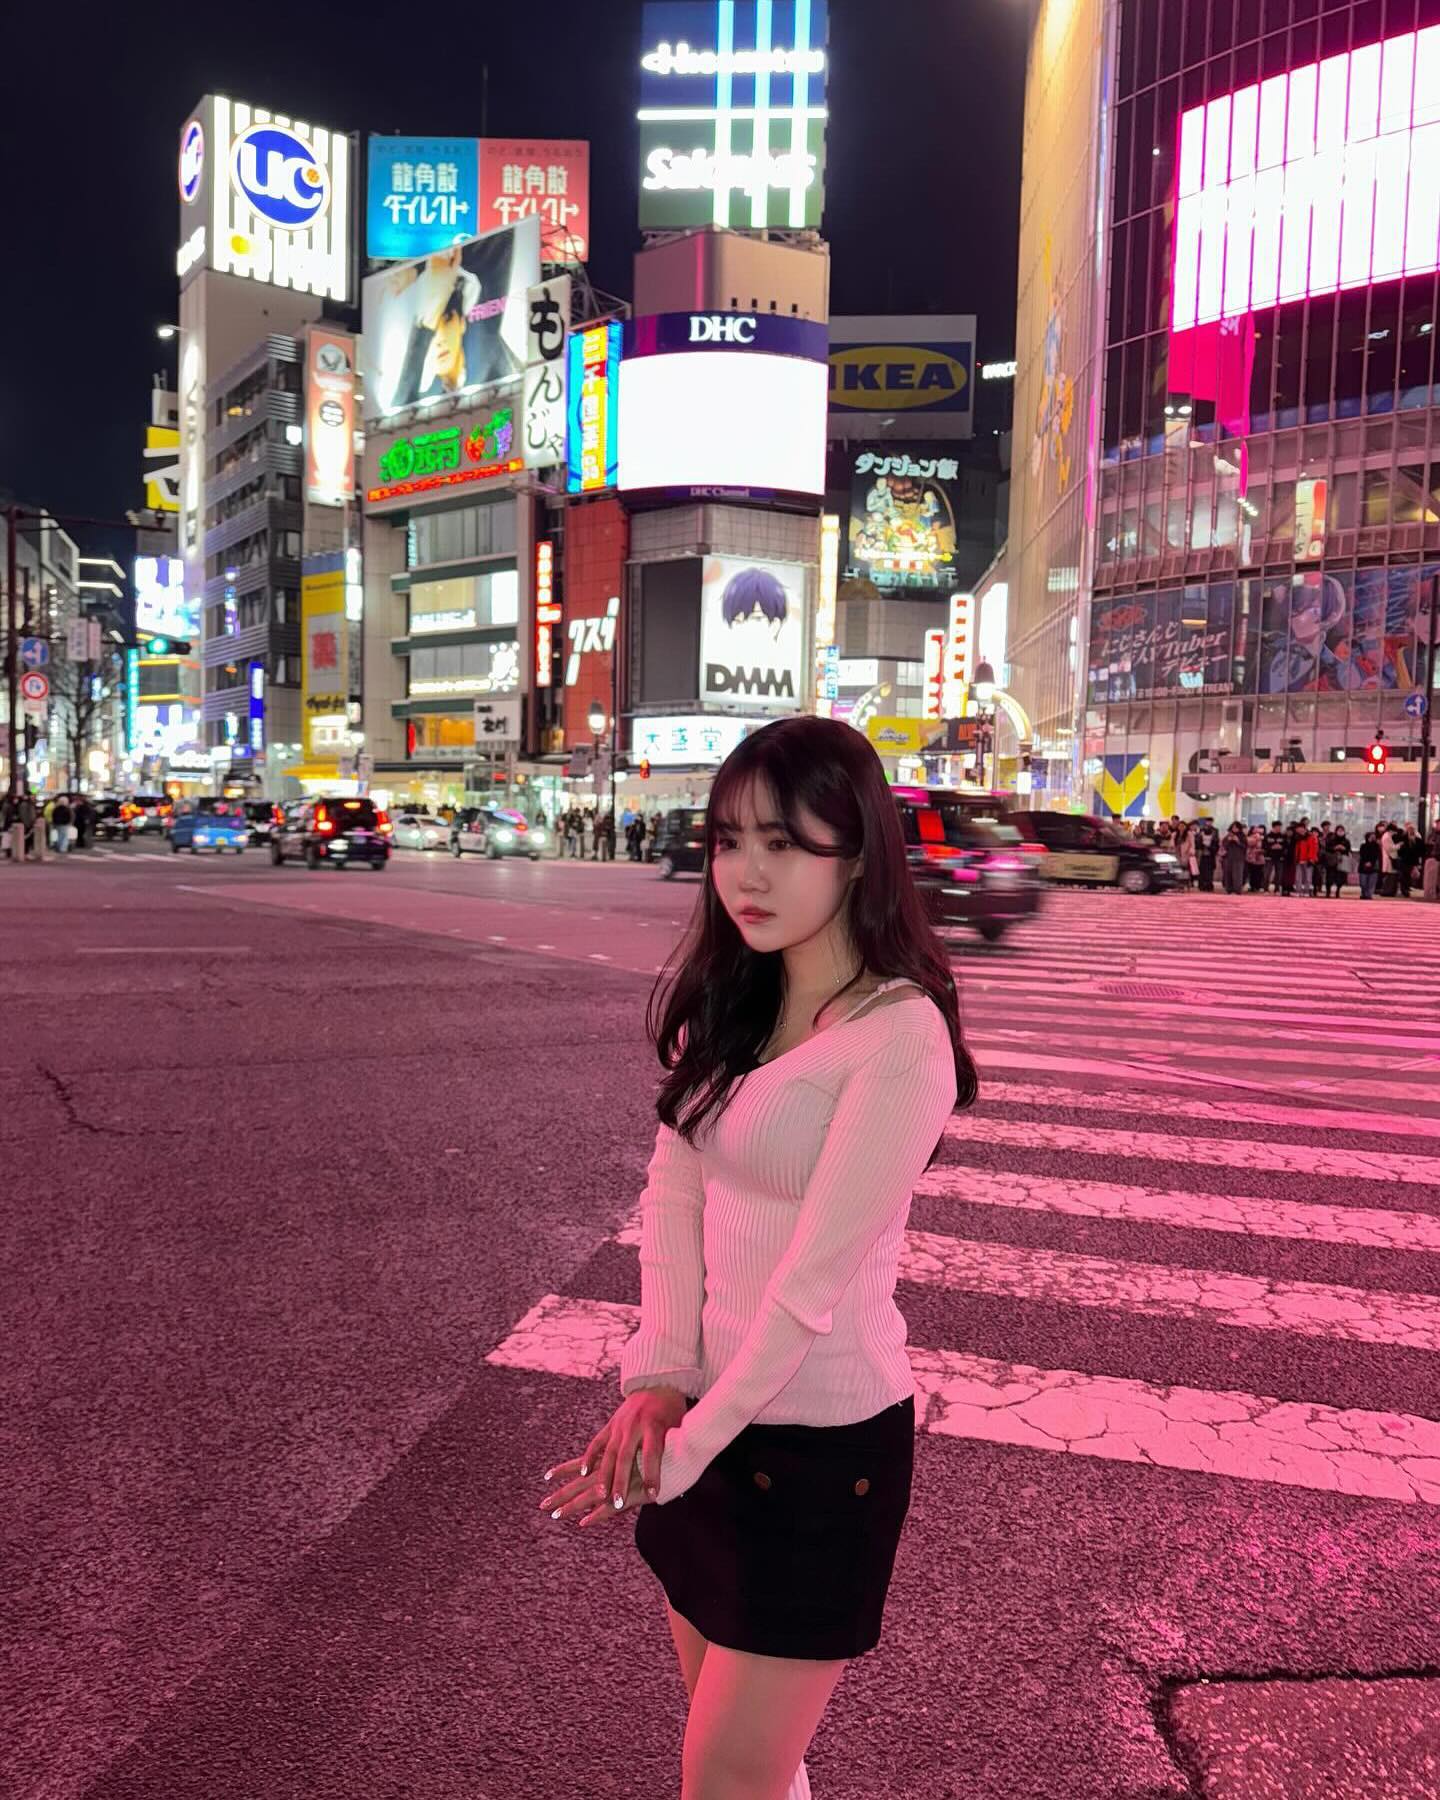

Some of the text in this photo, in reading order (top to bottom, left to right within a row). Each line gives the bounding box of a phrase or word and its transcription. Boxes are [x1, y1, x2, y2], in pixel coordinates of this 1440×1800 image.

[689, 315, 756, 343] DHC
[527, 287, 565, 457] もんじゃ
[706, 663, 794, 697] DMM
